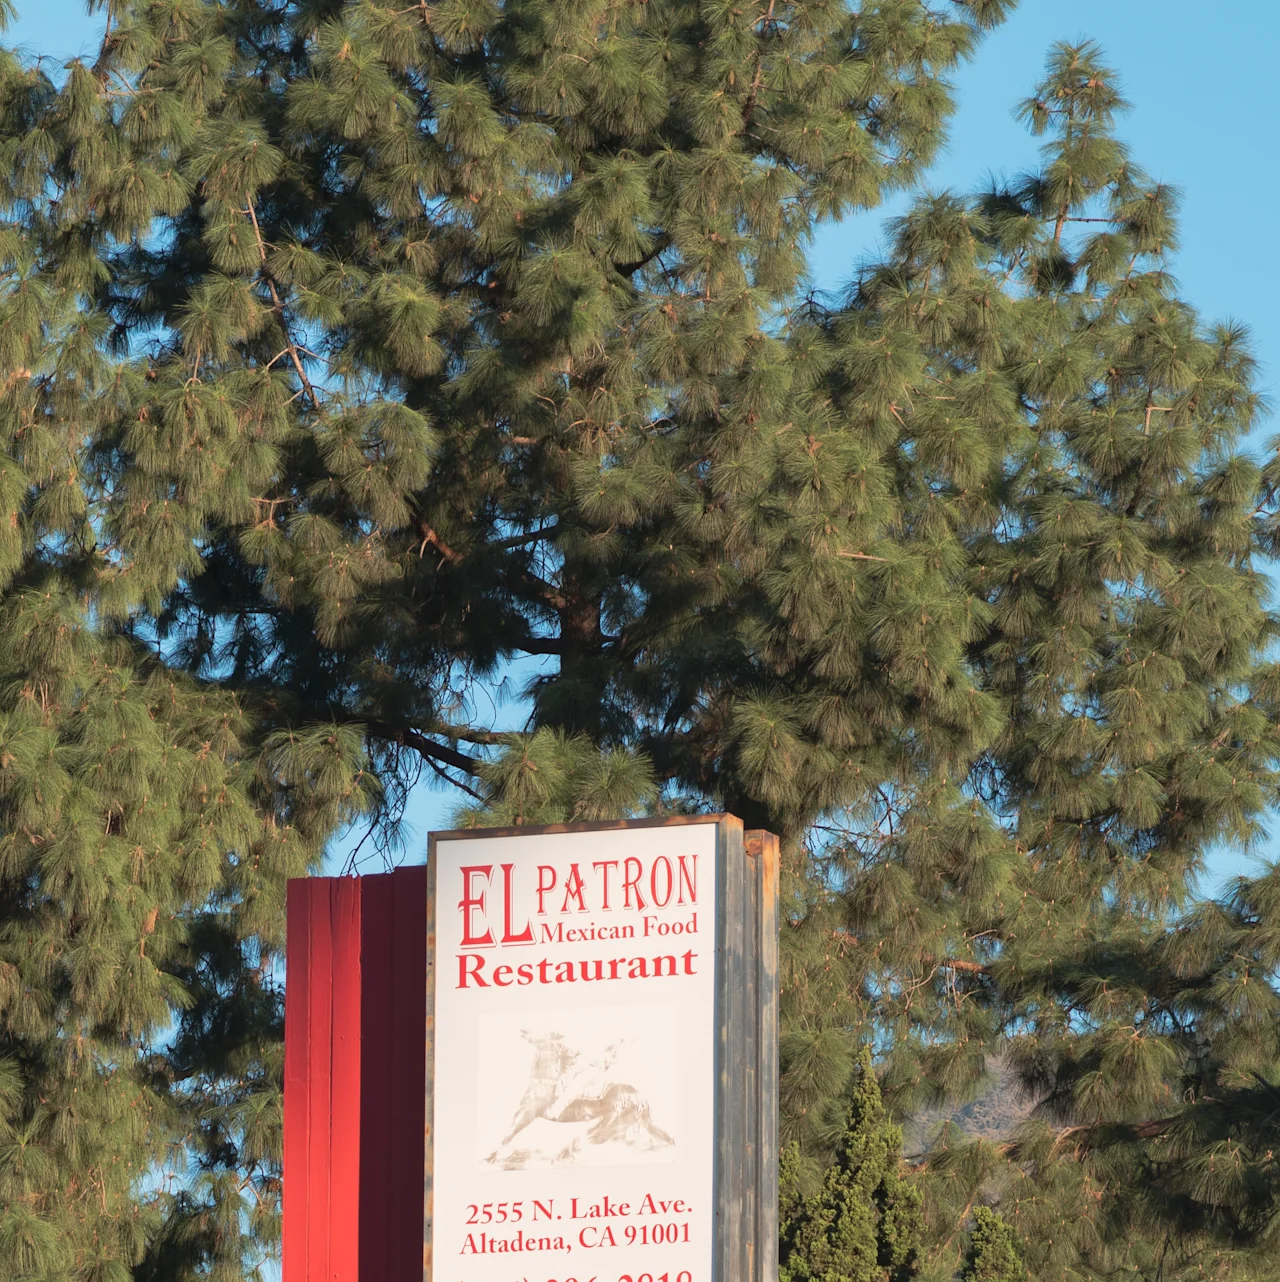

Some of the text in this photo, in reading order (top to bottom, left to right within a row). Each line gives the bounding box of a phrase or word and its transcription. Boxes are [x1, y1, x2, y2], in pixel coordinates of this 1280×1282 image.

[457, 855, 698, 949] EL PATRON
[540, 913, 698, 944] Mexican Food
[456, 948, 698, 989] Restaurant
[465, 1194, 692, 1225] 2555 N. Lake Ave.
[460, 1223, 690, 1255] Altadena, CA 91001
